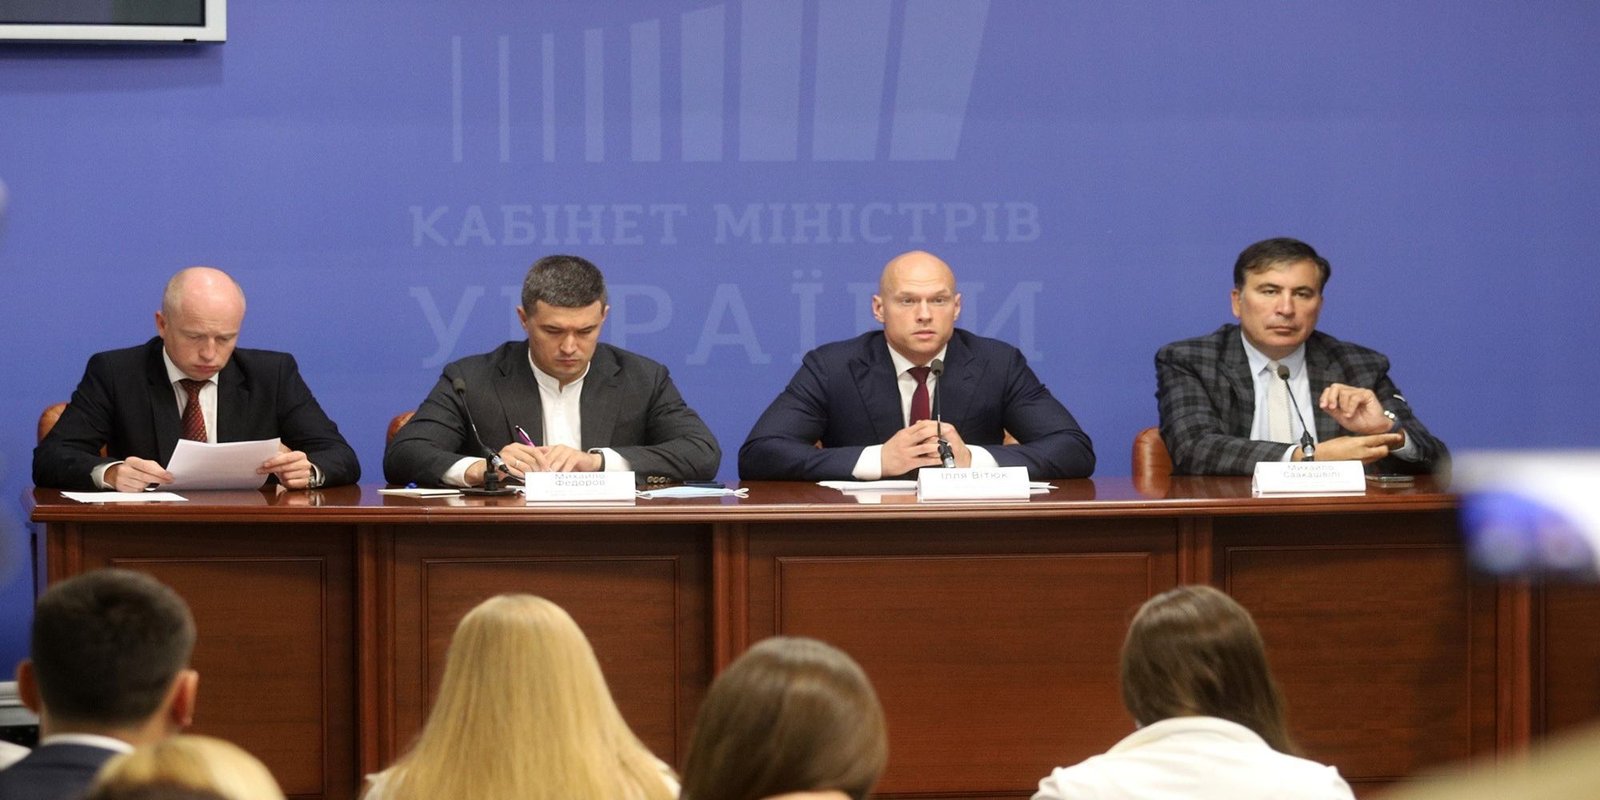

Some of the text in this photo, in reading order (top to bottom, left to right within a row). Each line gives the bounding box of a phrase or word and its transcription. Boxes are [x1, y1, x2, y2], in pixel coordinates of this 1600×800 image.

[409, 201, 1042, 247] КАБІНЕТ МІНІСТРІВ
[409, 269, 1044, 370] УРАЇИ
[554, 479, 607, 487] Федоров
[971, 471, 1009, 480] Вітюк
